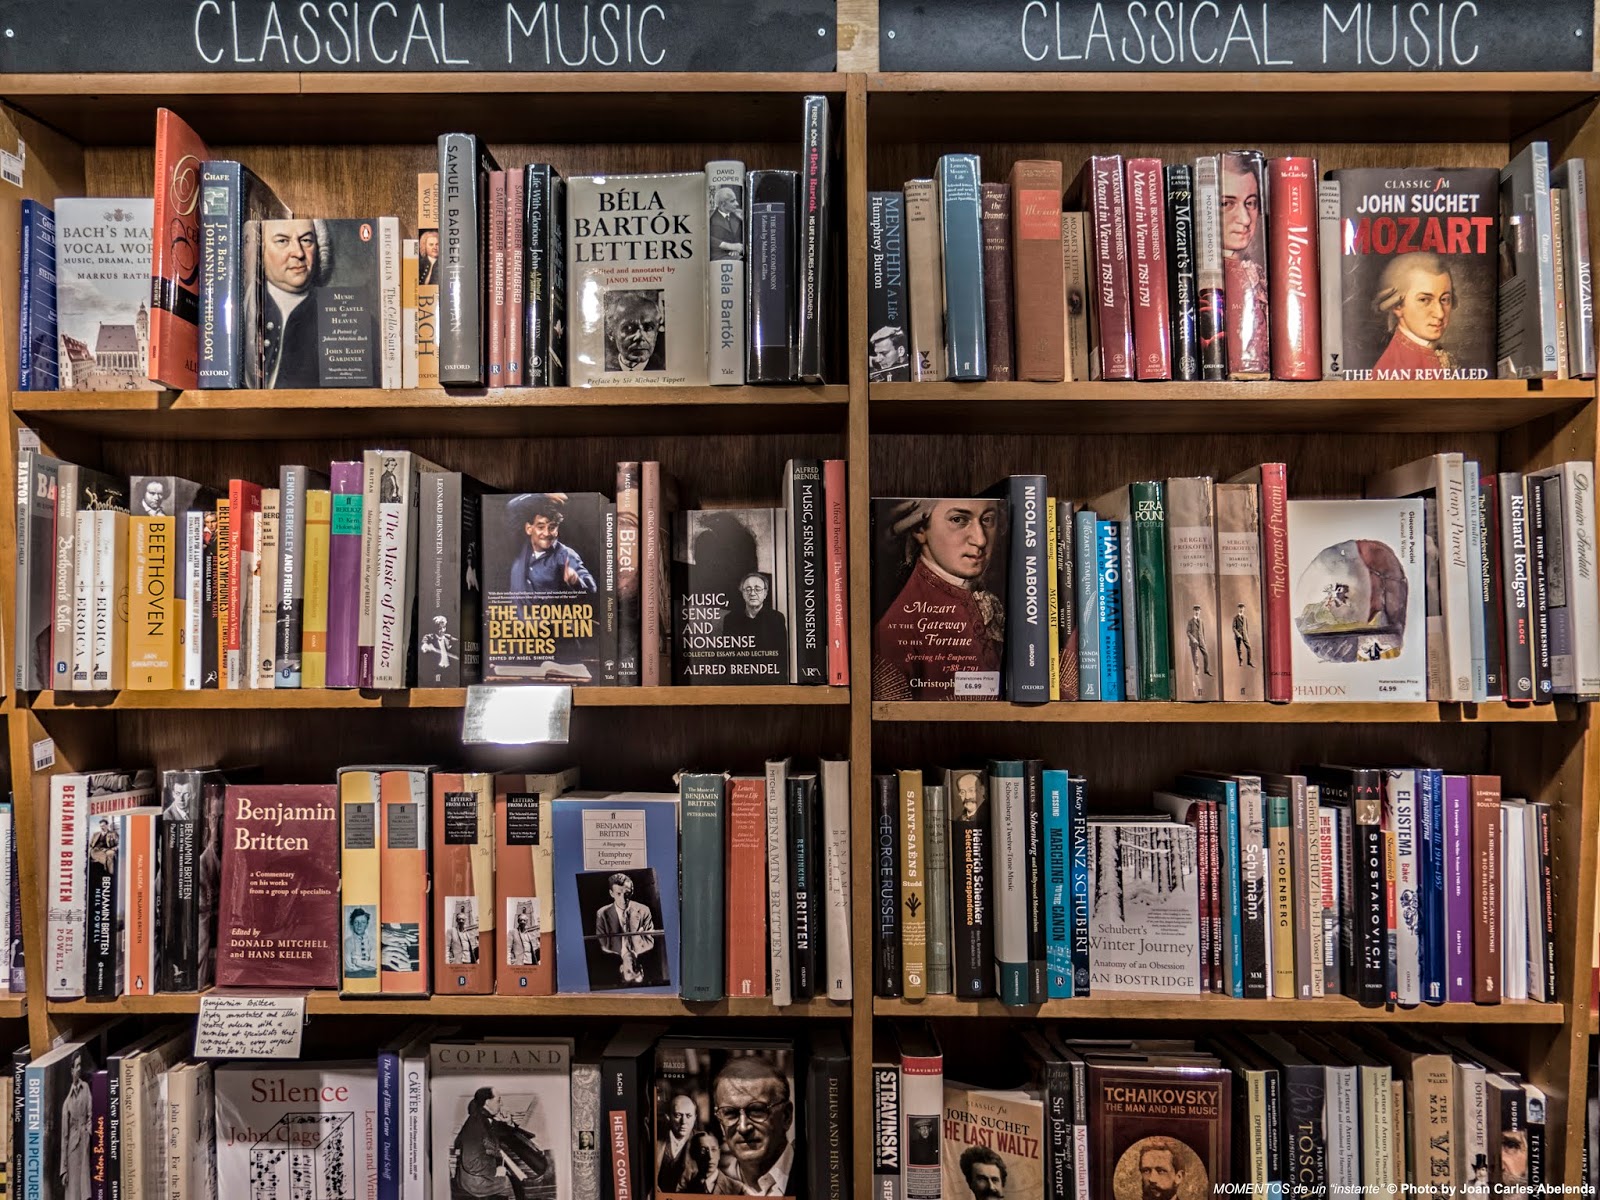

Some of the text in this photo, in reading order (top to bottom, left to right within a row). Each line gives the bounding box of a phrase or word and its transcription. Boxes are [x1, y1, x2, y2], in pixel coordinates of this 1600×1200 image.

[195, 1, 666, 65] CLASSICAL MUSIC
[1021, 2, 1478, 65] CLASSICAL MUSIC
[204, 173, 229, 181] CHAFE
[448, 145, 459, 202] SAMUEL
[1385, 180, 1432, 189] CLASSIC
[599, 189, 666, 212] BÉLA
[1357, 195, 1480, 213] JOHN SUCHET
[63, 225, 117, 238] BACH'S
[575, 214, 692, 237] BARTÓK
[448, 209, 461, 264] BARBER
[870, 197, 883, 289] Humphrey Burton
[885, 198, 901, 286] MENUHIN
[1341, 217, 1493, 255] MOZART
[64, 244, 114, 254] VOCAL
[575, 240, 693, 262] LETTERS
[667, 266, 676, 274] by
[721, 263, 733, 348] Béla Bartók
[888, 301, 897, 320] Life
[1343, 369, 1488, 381] THE MAN REVEALED
[1139, 501, 1162, 510] EZRA
[1511, 495, 1526, 548] Richard
[283, 471, 295, 611] LENNOX BERKELEY AND FRIENDS
[620, 529, 636, 572] Bizet
[1025, 486, 1037, 625] NICOLAS NABOKOV
[148, 523, 165, 636] BEETHOVEN
[1511, 552, 1527, 608] Rodgers
[381, 511, 399, 668] The Music of Berlioz
[682, 594, 729, 606] MUSIC,
[904, 602, 956, 613] Mozart
[489, 605, 592, 620] THE LEONARD
[682, 608, 720, 620] SENSE
[489, 620, 593, 638] BERNSTEIN
[682, 622, 713, 634] AND
[917, 618, 967, 632] Gateway
[490, 639, 556, 654] LETTERS
[683, 636, 756, 648] NONSENSE
[925, 634, 972, 646] Fortune
[906, 654, 933, 663] Serving
[947, 653, 977, 663] Emperor,
[684, 664, 779, 675] ALFRED BRENDEL
[910, 679, 955, 689] Christoph
[236, 798, 337, 826] Benjamin
[1397, 791, 1412, 857] EL SISTEMA
[60, 785, 75, 902] BENJAMIN BRITTEN
[235, 828, 309, 851] Britten
[906, 791, 917, 877] SAINT-SAËNS
[598, 851, 632, 860] Humphrey
[256, 871, 295, 879] Commentary
[972, 829, 983, 925] Heinrich Schenker
[1246, 844, 1258, 920] Schumann
[1278, 842, 1287, 927] SCHOENBERG
[1074, 818, 1088, 955] FRANZ SCHUBERT
[1369, 834, 1381, 969] SHOSTAKOVICH
[797, 892, 808, 949] BRITTEN
[1098, 924, 1147, 934] Schubert's
[253, 929, 260, 937] by
[231, 939, 328, 948] DONALD MITCHELL
[1088, 939, 1194, 956] Winter Journey
[248, 951, 275, 959] HANS
[279, 951, 313, 959] KELLER
[1094, 960, 1127, 969] Anatomy
[1129, 960, 1137, 968] of
[1149, 961, 1185, 969] Obsession
[1115, 974, 1194, 987] BOSTRIDGE
[439, 1049, 561, 1064] COPLAND
[252, 1078, 349, 1103] Silence
[1104, 1087, 1218, 1105] TCHAIKOVSKY
[29, 1078, 40, 1130] BRITTEN
[1104, 1103, 1218, 1116] THE MAN AND HIS MUSIC
[880, 1071, 898, 1168] STRAVINSKY
[228, 1127, 320, 1147] John Cage
